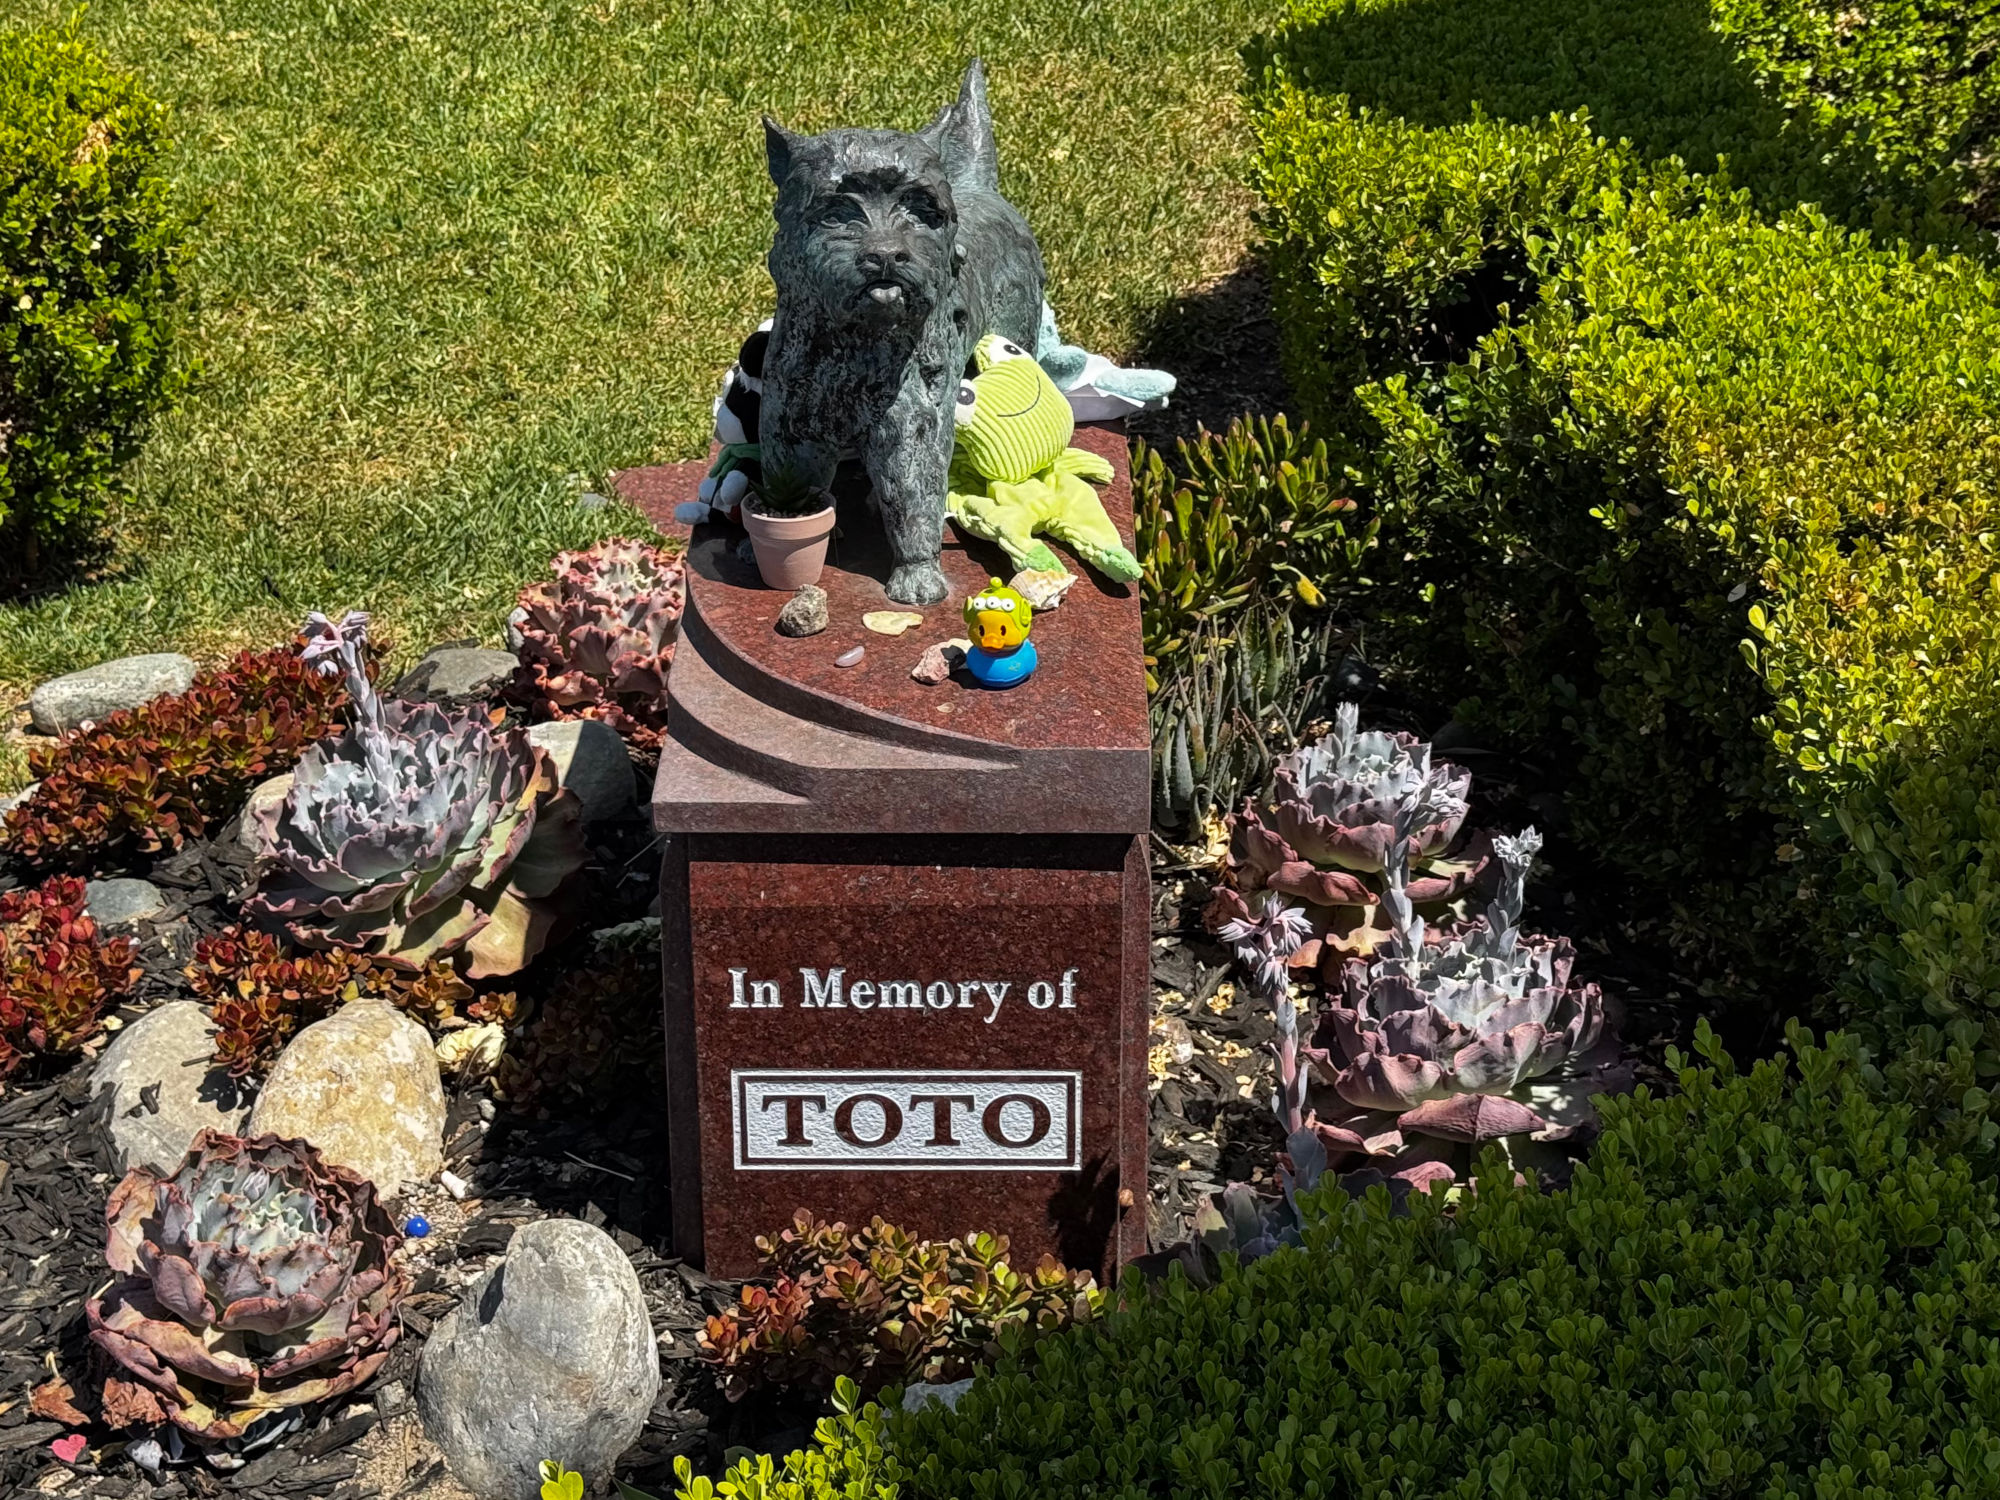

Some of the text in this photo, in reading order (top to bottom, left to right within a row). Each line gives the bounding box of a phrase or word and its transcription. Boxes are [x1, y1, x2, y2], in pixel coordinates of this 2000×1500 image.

[728, 966, 1080, 1024] In Memory of
[761, 1093, 1052, 1148] TOTO
